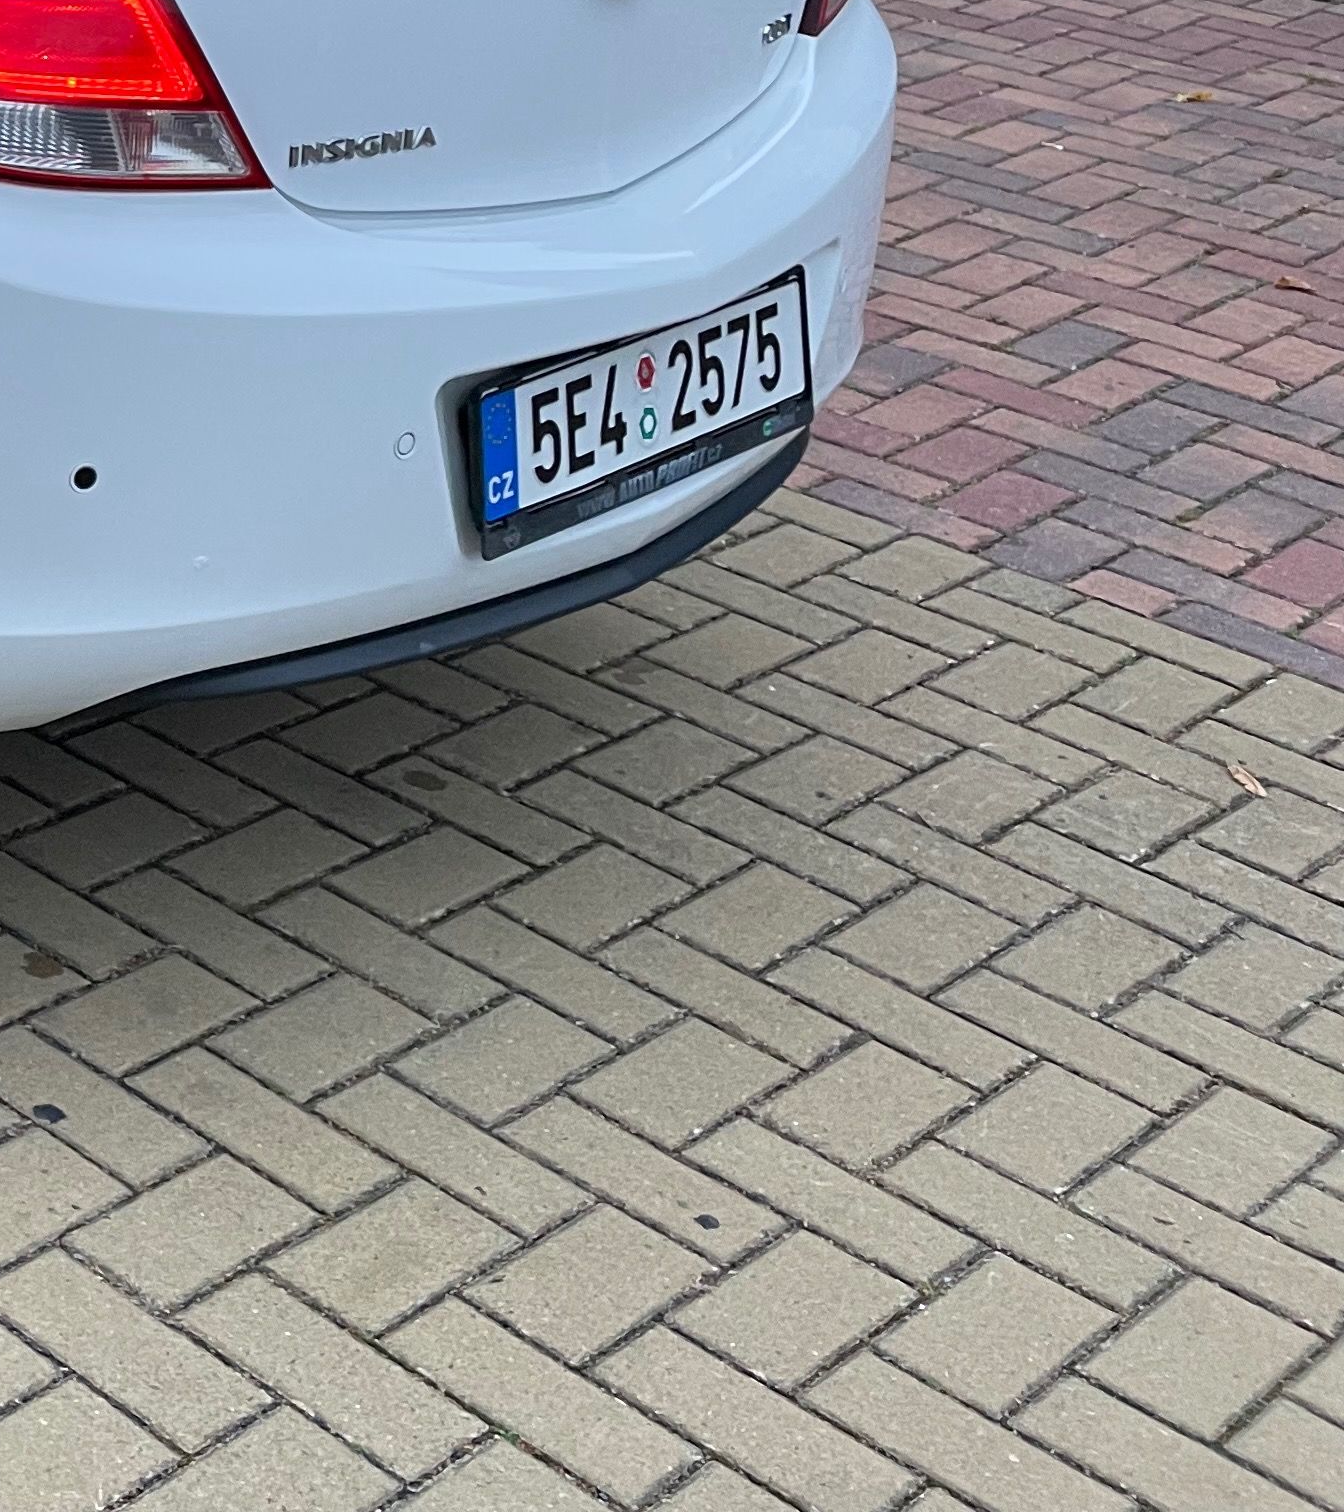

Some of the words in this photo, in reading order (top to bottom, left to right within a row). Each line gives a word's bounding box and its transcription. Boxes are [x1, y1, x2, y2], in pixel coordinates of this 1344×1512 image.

[288, 126, 437, 168] INSIGNIA
[531, 364, 627, 484] 5E4
[667, 302, 782, 432] 2575
[488, 471, 515, 504] CZ
